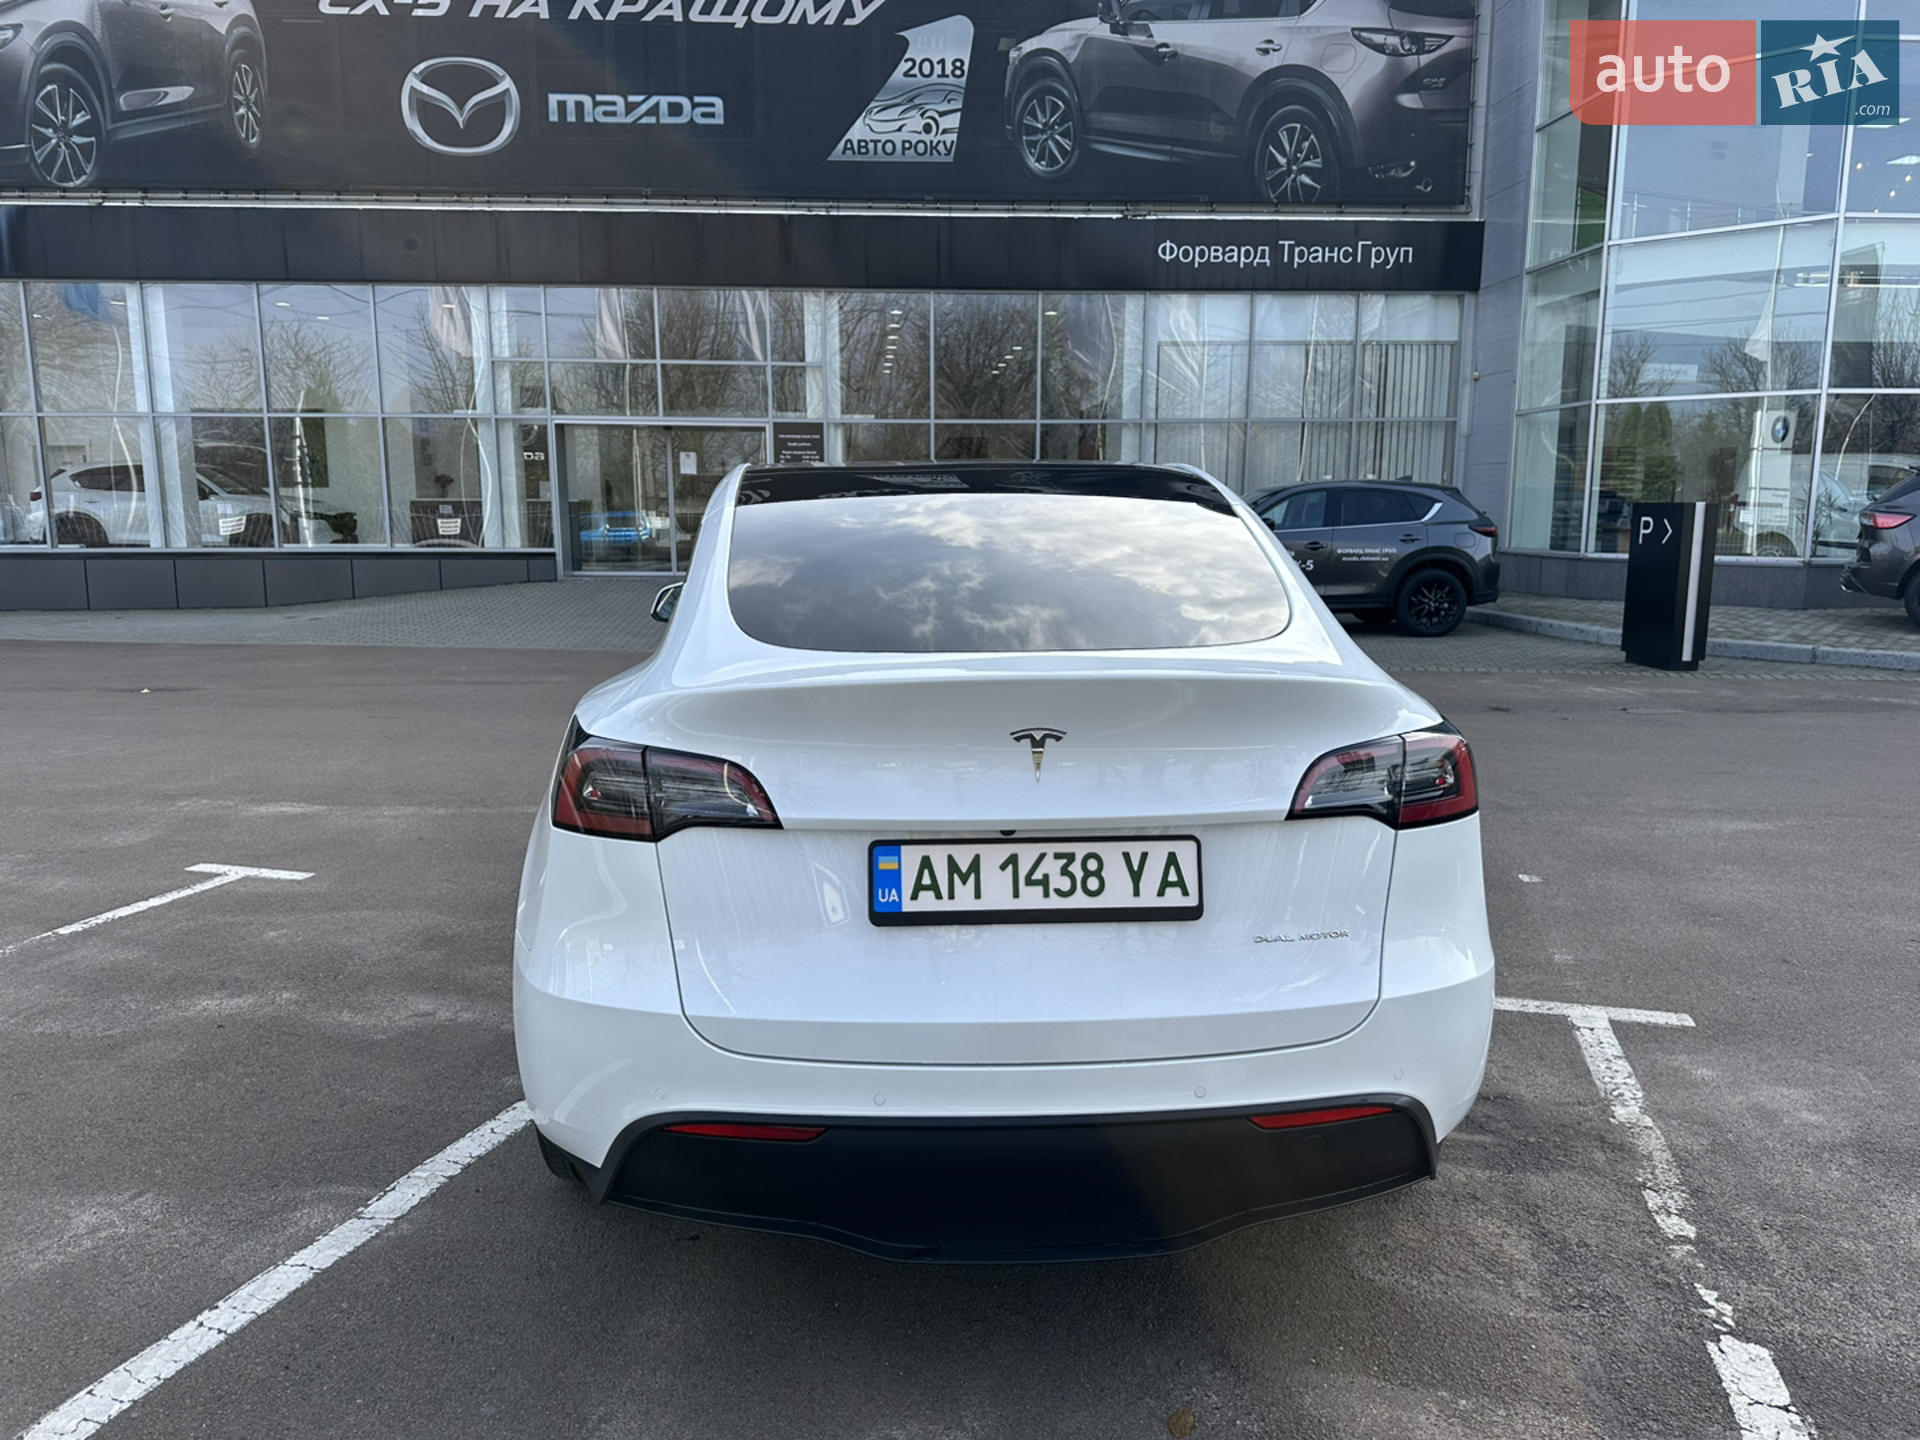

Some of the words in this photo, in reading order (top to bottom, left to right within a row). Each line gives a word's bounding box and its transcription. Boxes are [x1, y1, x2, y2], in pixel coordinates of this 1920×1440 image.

[468, 0, 550, 19] НА
[567, 0, 886, 28] КРАЩОМУ
[902, 57, 966, 79] 2018
[841, 138, 897, 156] АВТО
[901, 139, 956, 157] РОКУ
[1157, 239, 1271, 268] Форвард
[1278, 240, 1353, 269] Транс
[1356, 240, 1414, 269] Груп
[1639, 516, 1654, 545] P
[909, 854, 982, 901] AM
[999, 852, 1106, 899] 1438
[1122, 851, 1190, 898] YA
[878, 888, 899, 902] UA
[1254, 934, 1296, 944] DUAL
[1299, 929, 1350, 941] MOTOR
